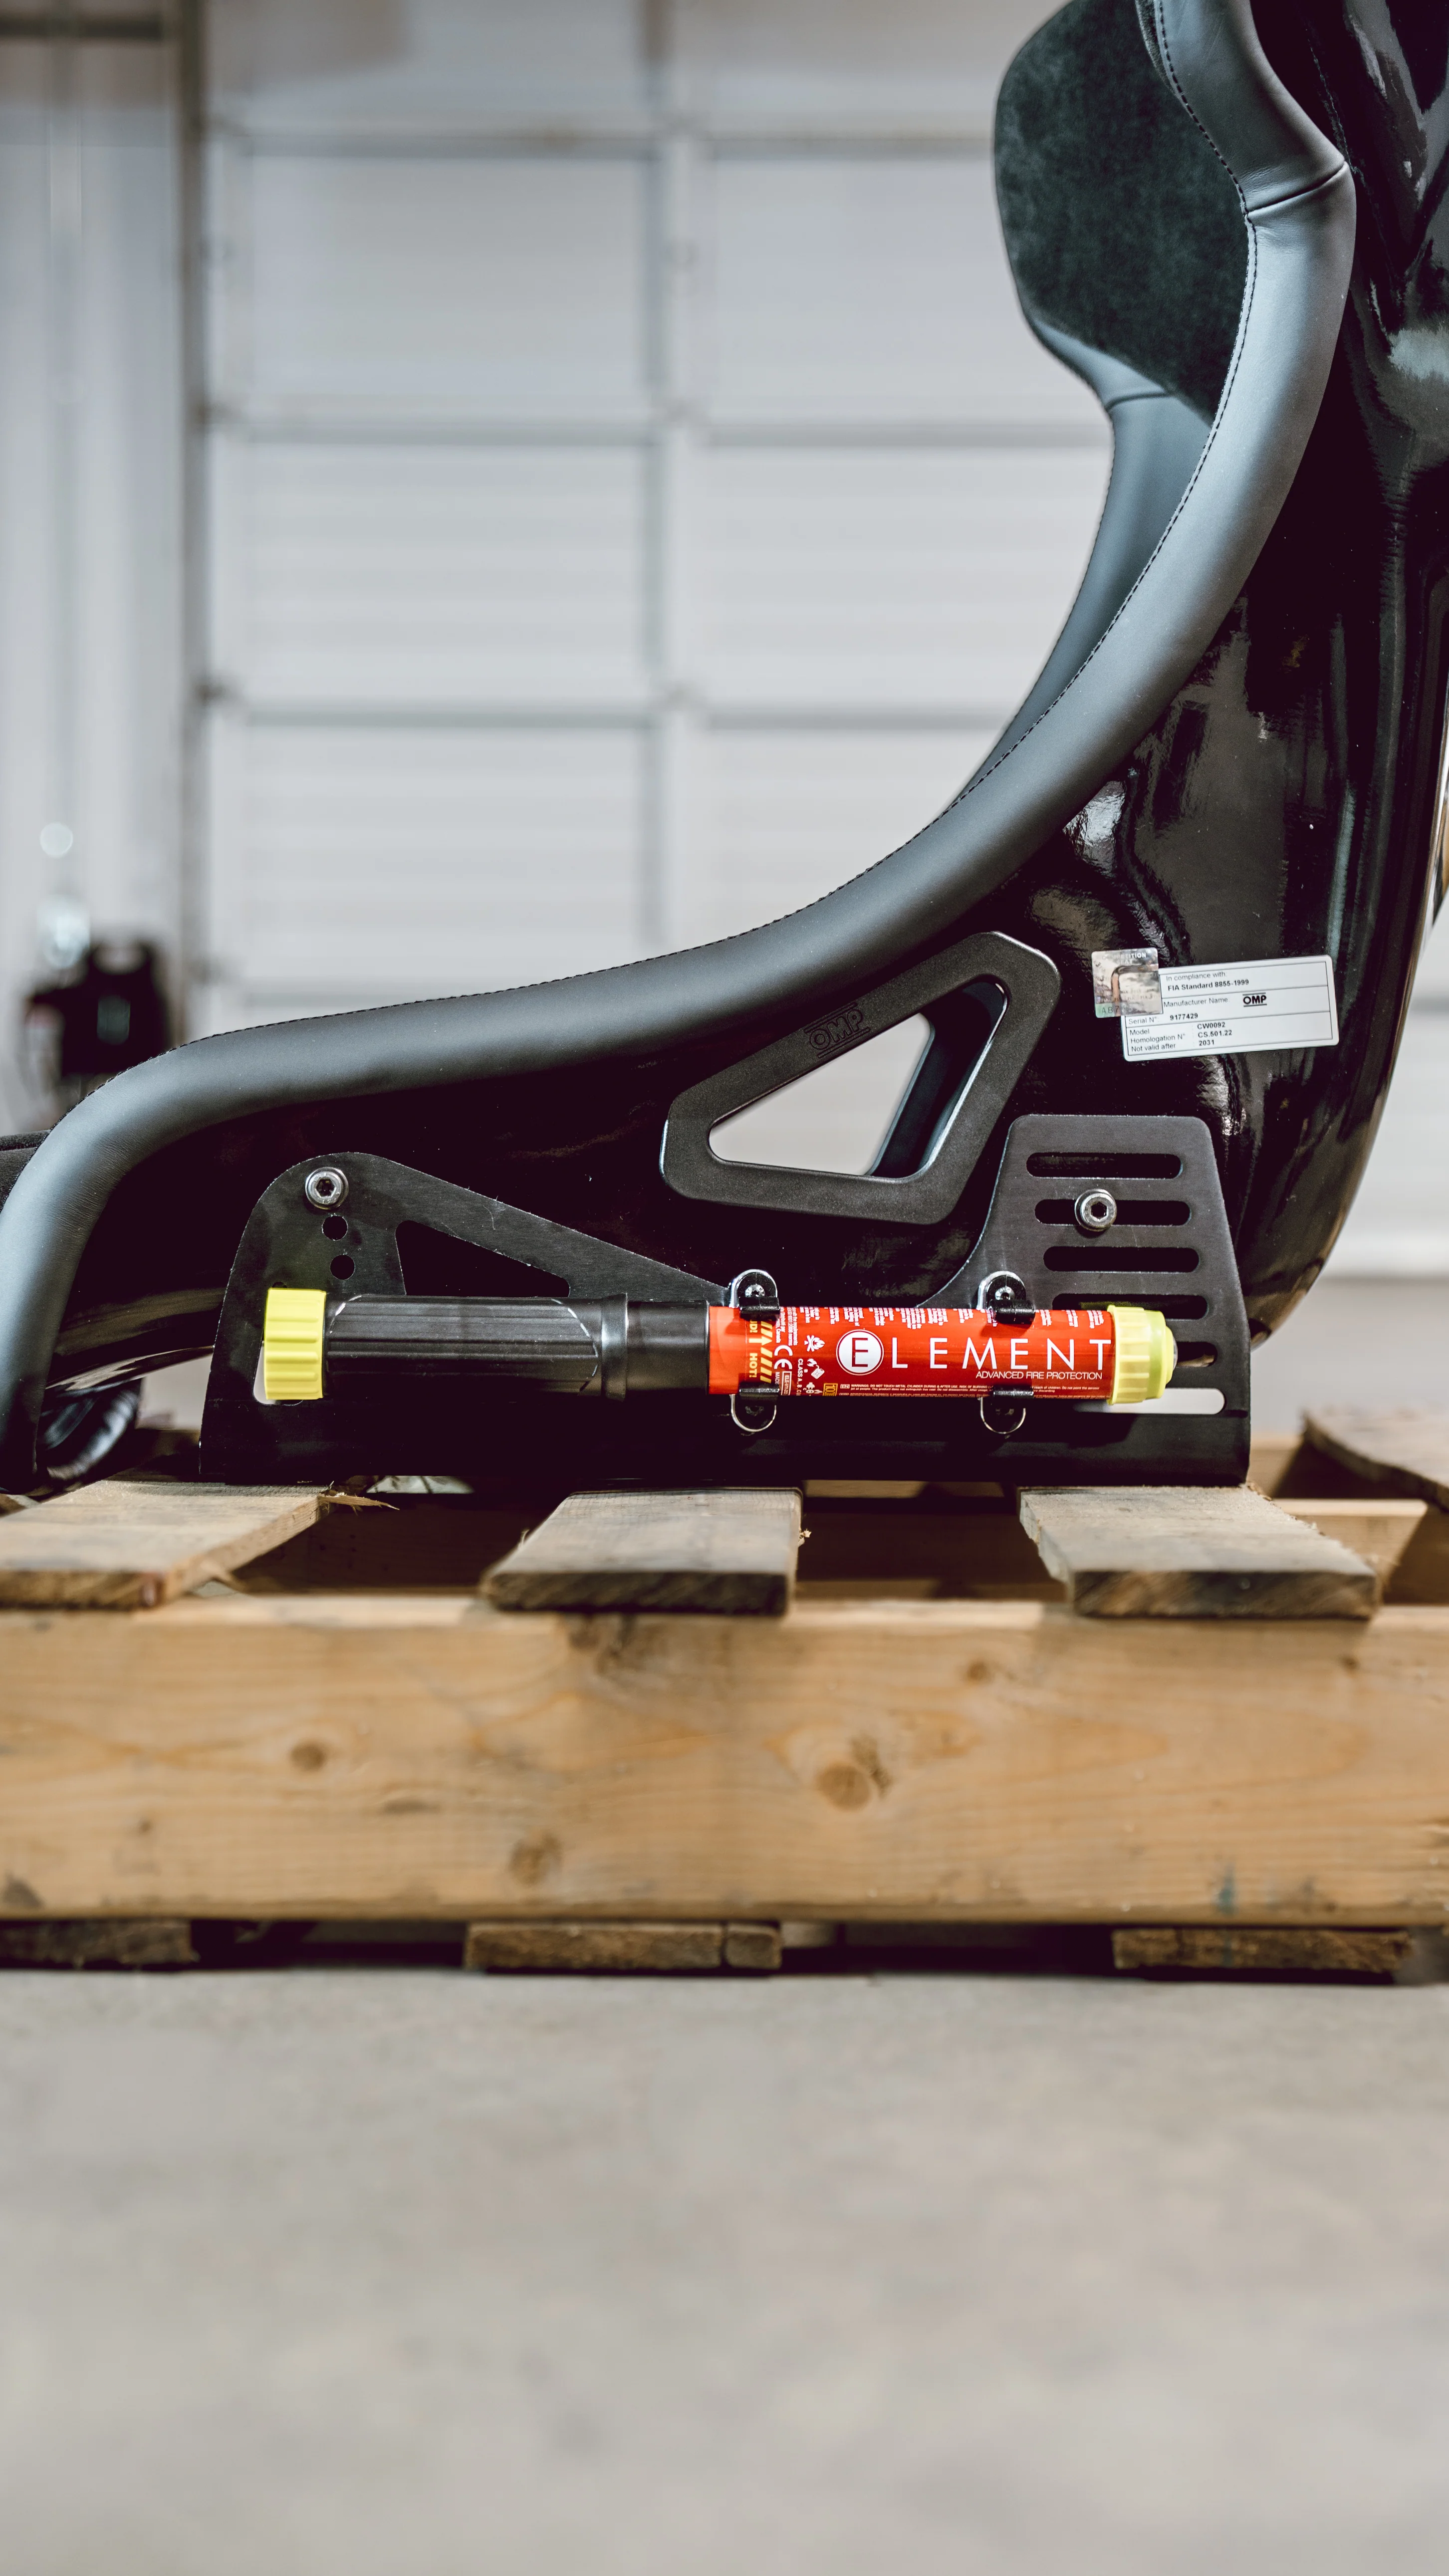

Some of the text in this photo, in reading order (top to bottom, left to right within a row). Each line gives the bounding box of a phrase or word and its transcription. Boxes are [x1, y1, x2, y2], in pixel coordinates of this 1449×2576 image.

[1174, 972, 1211, 981] compliance
[1182, 982, 1213, 990] Standard
[1164, 998, 1207, 1007] Manufacturer
[1243, 994, 1267, 1005] OMP
[1128, 1016, 1147, 1024] Serial
[808, 1006, 864, 1051] OMP
[1198, 1029, 1232, 1038] CS.501.22
[1131, 1034, 1176, 1044] Homologation
[749, 1353, 758, 1378] HOT!
[975, 1371, 1103, 1380] ADVANCED FIRE PROTECTION
